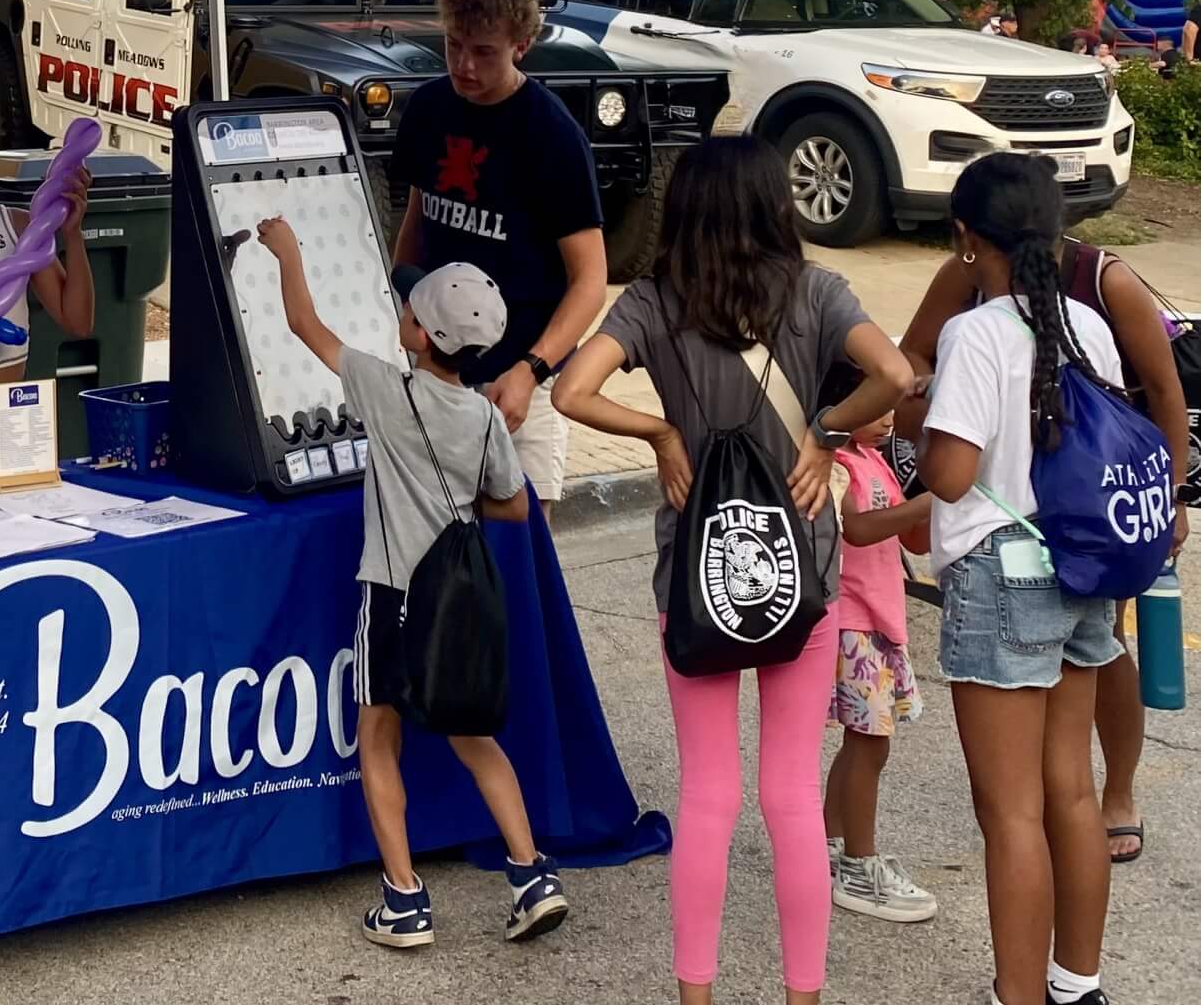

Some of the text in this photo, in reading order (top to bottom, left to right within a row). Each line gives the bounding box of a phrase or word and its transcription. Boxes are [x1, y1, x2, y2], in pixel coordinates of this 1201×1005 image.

[56, 34, 165, 70] ROLLING MEADOWS
[37, 53, 178, 129] POLICE
[213, 122, 263, 150] Bacoa
[421, 191, 507, 241] OOTBALL
[718, 508, 770, 533] OLICE
[707, 537, 743, 630] BARRINGTON
[765, 536, 794, 623] ILLINOIS
[111, 804, 142, 821] aging
[252, 776, 313, 797] Education.
